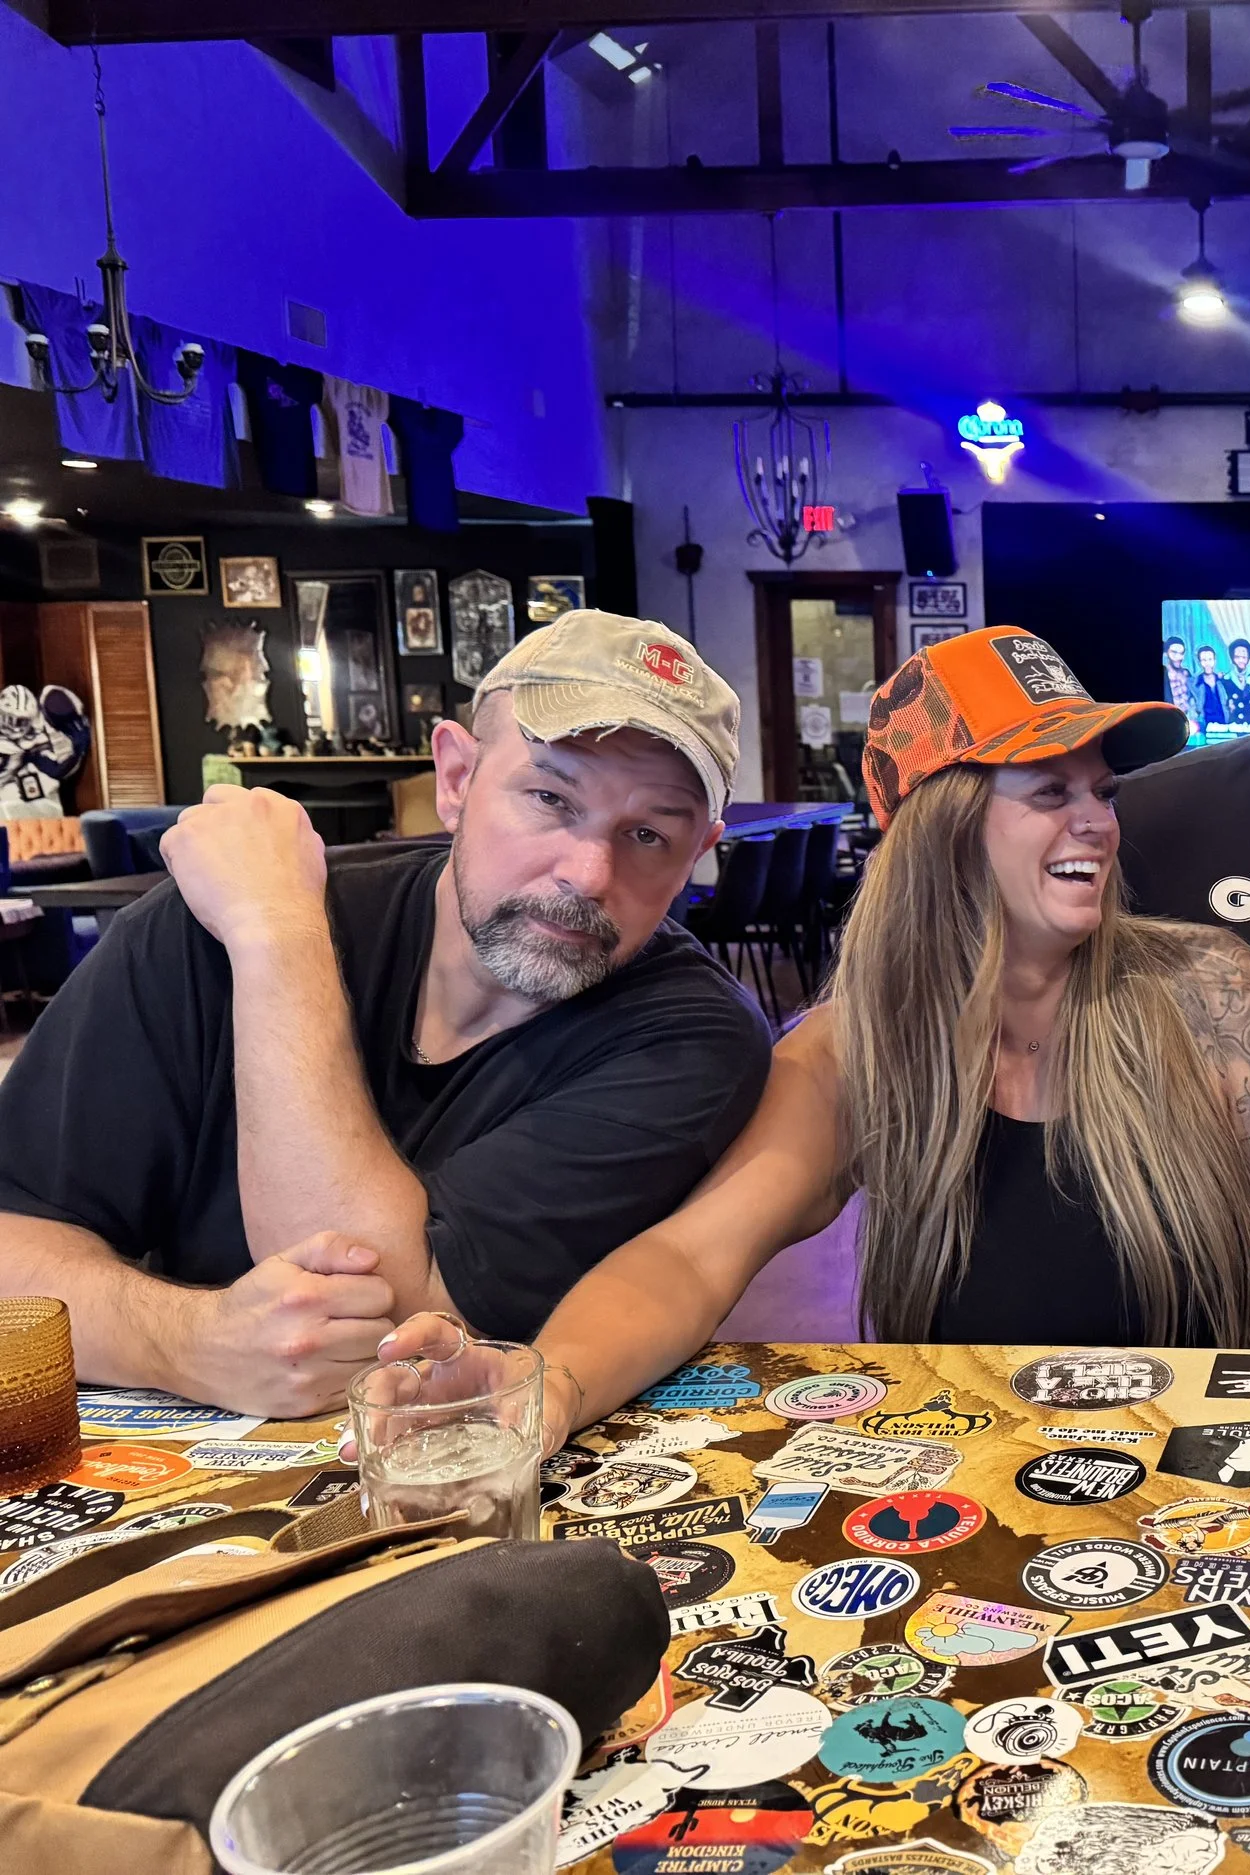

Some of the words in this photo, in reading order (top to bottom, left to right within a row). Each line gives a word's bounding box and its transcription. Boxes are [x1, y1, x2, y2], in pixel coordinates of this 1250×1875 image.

[803, 506, 835, 532] EXIT
[636, 642, 694, 685] M-G
[1035, 1377, 1062, 1390] A
[1073, 1375, 1152, 1387] LIKE
[649, 1387, 752, 1398] CORRIDO
[1097, 1435, 1138, 1444] Kayla
[840, 1441, 911, 1455] WHISKEY
[189, 1451, 291, 1461] BRAUNFELS
[1047, 1454, 1094, 1465] TEXAS
[1034, 1459, 1133, 1486] BRAUNFELS
[1073, 1480, 1122, 1499] NEW
[620, 1513, 654, 1527] Since
[659, 1501, 730, 1529] Villa
[702, 1515, 731, 1524] The
[564, 1519, 616, 1535] 2012
[916, 1514, 977, 1549] TEQUILA
[851, 1523, 911, 1552] CORRIDO
[1051, 1544, 1081, 1559] FAIL
[1084, 1543, 1129, 1554] WORDS
[1128, 1546, 1157, 1579] WHERE
[1180, 1560, 1244, 1572] SCENE
[804, 1562, 909, 1616] OMEGA
[1030, 1574, 1071, 1605] SPEAKS
[1072, 1591, 1127, 1605] MUSIC
[930, 1604, 1051, 1633] MEANWHILE
[981, 1606, 1034, 1620] BREWING
[1057, 1613, 1246, 1677] YETI
[709, 1647, 790, 1678] TEQUILA
[690, 1662, 738, 1682] RIOS
[730, 1675, 772, 1693] DOS
[763, 1715, 823, 1728] TREVOR
[657, 1721, 760, 1740] UNDERWOOD
[750, 1726, 825, 1746] Small
[652, 1735, 740, 1753] Circles
[919, 1750, 944, 1766] The
[697, 1799, 725, 1807] MUSIC
[727, 1798, 758, 1806] TEXAS
[668, 1844, 747, 1858] KINGDOM
[655, 1859, 745, 1873] CAMPFIRE
[851, 1854, 903, 1866] BASTARDS
